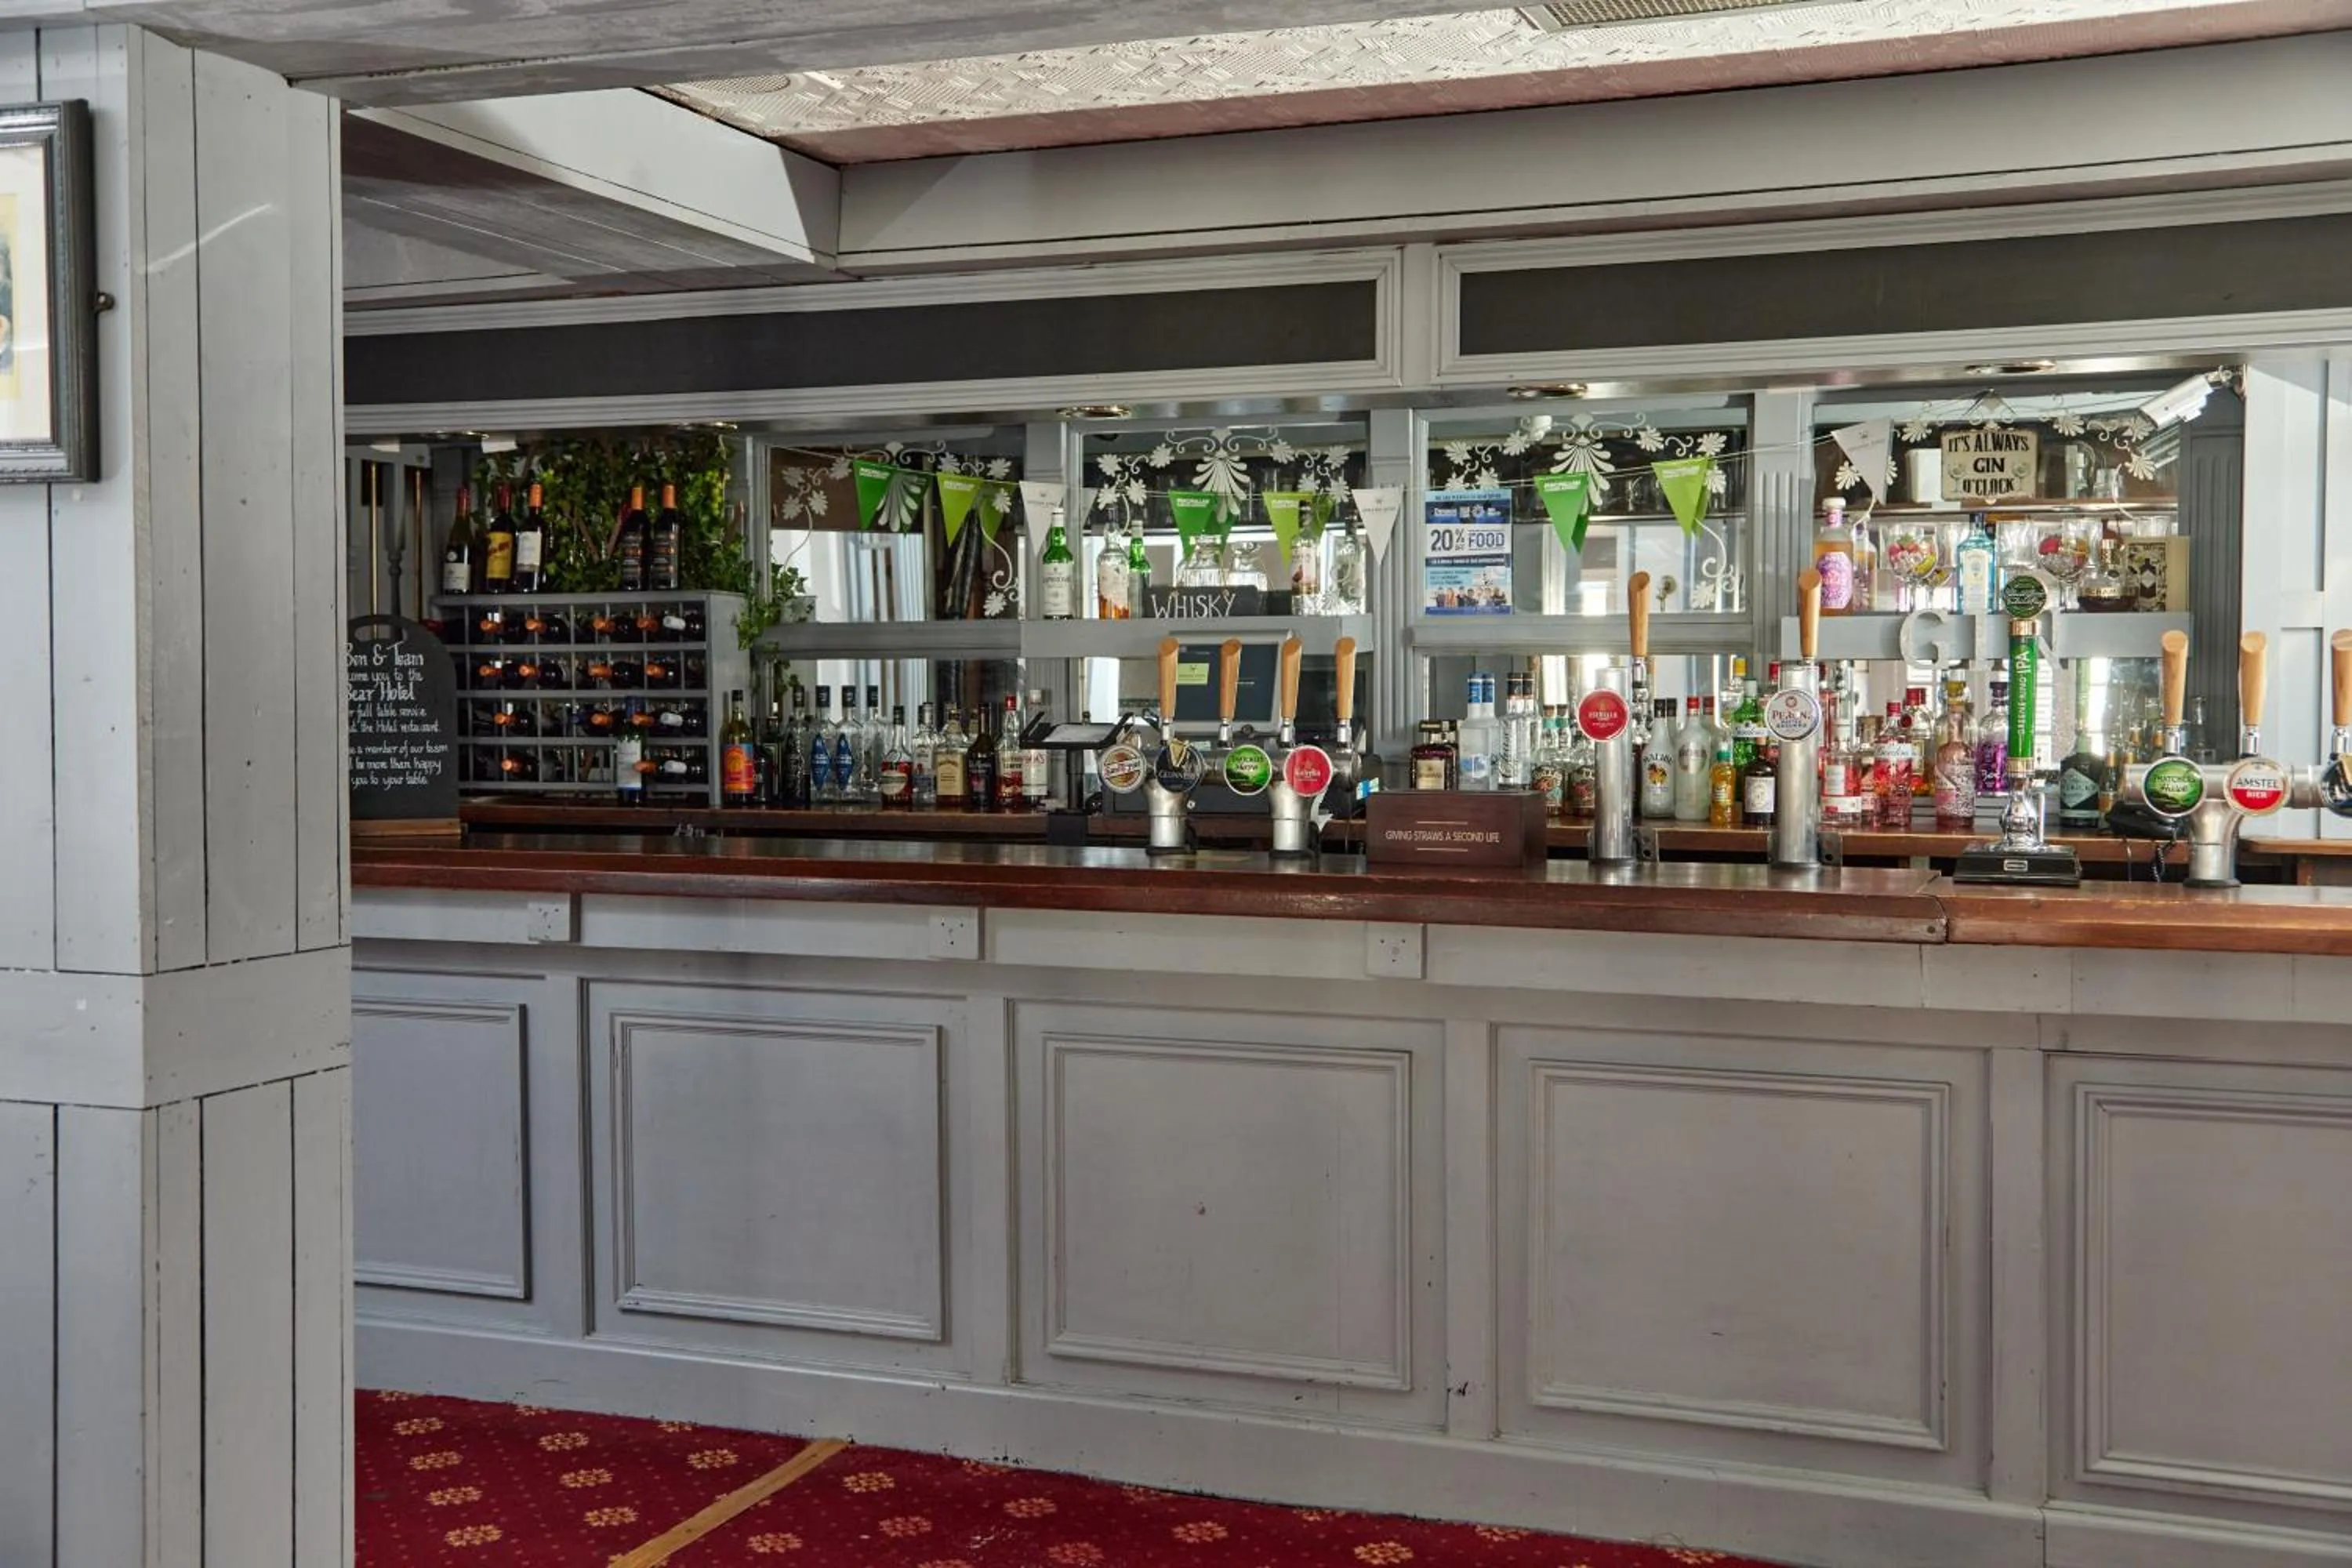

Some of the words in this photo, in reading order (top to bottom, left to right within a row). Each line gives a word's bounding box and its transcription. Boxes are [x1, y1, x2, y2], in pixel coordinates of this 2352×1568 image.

[1948, 434, 1970, 452] IT'S
[1973, 432, 2030, 452] ALWAYS
[1973, 457, 2005, 474] GIN
[1962, 477, 2015, 496] O'CLOCK
[1468, 532, 1504, 548] FOOD
[1151, 593, 1236, 620] WHISKY
[372, 644, 387, 666] &
[2015, 650, 2032, 673] IPA
[394, 667, 403, 681] to
[408, 667, 423, 681] the
[379, 681, 415, 700] Hotel
[365, 739, 398, 753] member
[413, 757, 441, 775] happy
[369, 771, 379, 785] to
[2236, 777, 2278, 789] AMSTEL
[2246, 789, 2267, 799] BIER
[1385, 830, 1412, 840] GIVING
[1414, 831, 1443, 841] STRAWS
[1445, 833, 1451, 841] A
[1452, 832, 1484, 843] SECOND
[1486, 832, 1500, 843] LIFE
